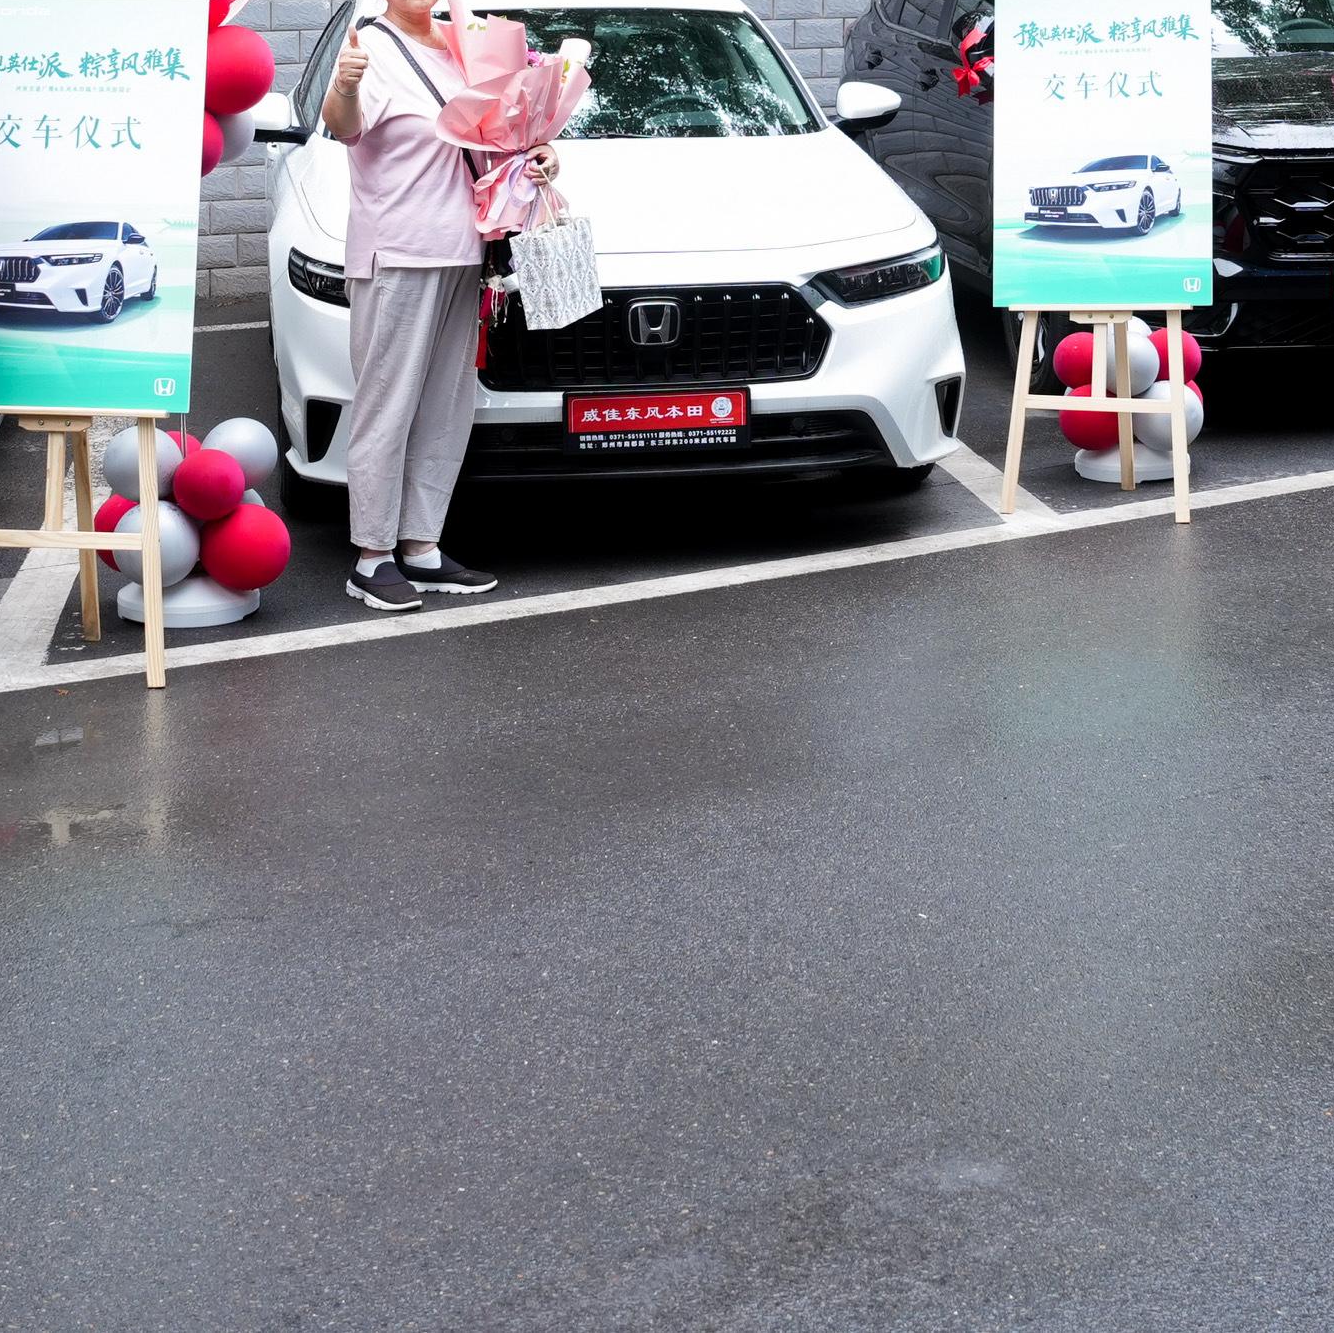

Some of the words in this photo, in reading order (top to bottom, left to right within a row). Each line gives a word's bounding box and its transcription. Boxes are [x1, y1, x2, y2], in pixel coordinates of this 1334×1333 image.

[1013, 20, 1105, 52] 豫见英仕派
[78, 47, 191, 82] 粽享风雅集
[1043, 70, 1163, 101] 交车仪式
[581, 405, 703, 423] 威佳东风本田
